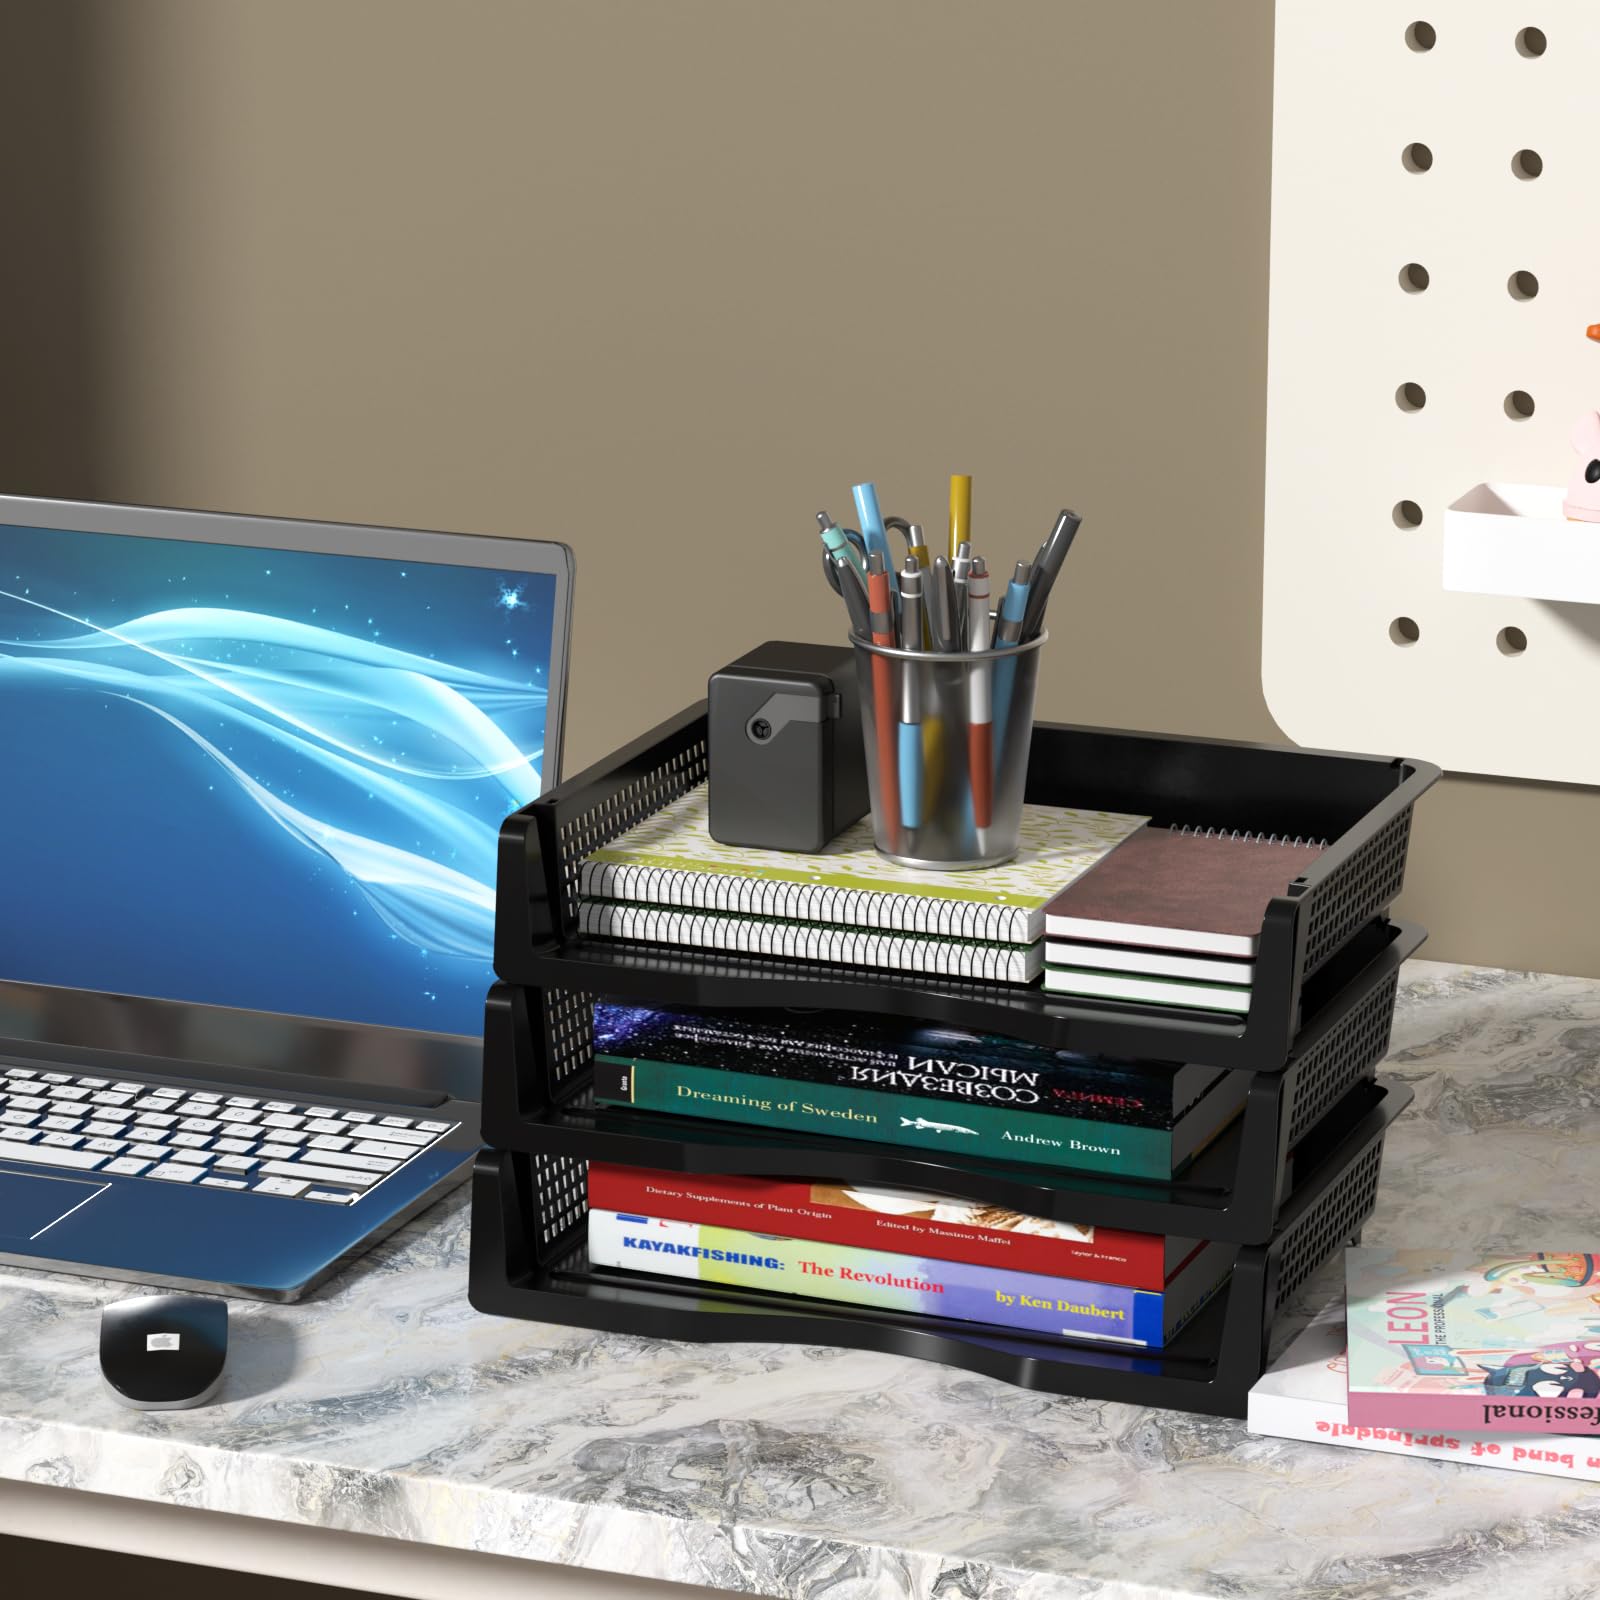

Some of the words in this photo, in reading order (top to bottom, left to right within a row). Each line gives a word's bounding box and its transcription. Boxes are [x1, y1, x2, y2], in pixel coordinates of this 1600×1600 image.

[850, 1066, 1041, 1104] СОЗВЕЗДИЯ
[676, 1085, 772, 1112] Dreaming
[777, 1101, 798, 1112] of
[801, 1103, 878, 1124] Sweden
[1001, 1130, 1063, 1148] Andrew
[1069, 1139, 1121, 1156] Brown
[646, 1185, 683, 1198] Dietary
[686, 1191, 751, 1208] Supplements
[753, 1202, 766, 1210] of
[767, 1203, 794, 1214] Plant
[797, 1208, 833, 1219] Origin
[876, 1219, 910, 1231] Edited
[912, 1223, 925, 1233] by
[928, 1227, 975, 1240] Massimo
[977, 1234, 1012, 1246] Maffei
[623, 1236, 785, 1271] KAYAKFISHING:
[798, 1260, 835, 1278] The
[839, 1266, 945, 1294] Revolution
[995, 1290, 1016, 1307] by
[1020, 1294, 1053, 1310] Ken
[1057, 1299, 1126, 1320] Daubert
[1385, 1291, 1430, 1345] LEON
[1435, 1334, 1447, 1345] THE
[1471, 1441, 1501, 1457] of
[1512, 1446, 1574, 1469] band
